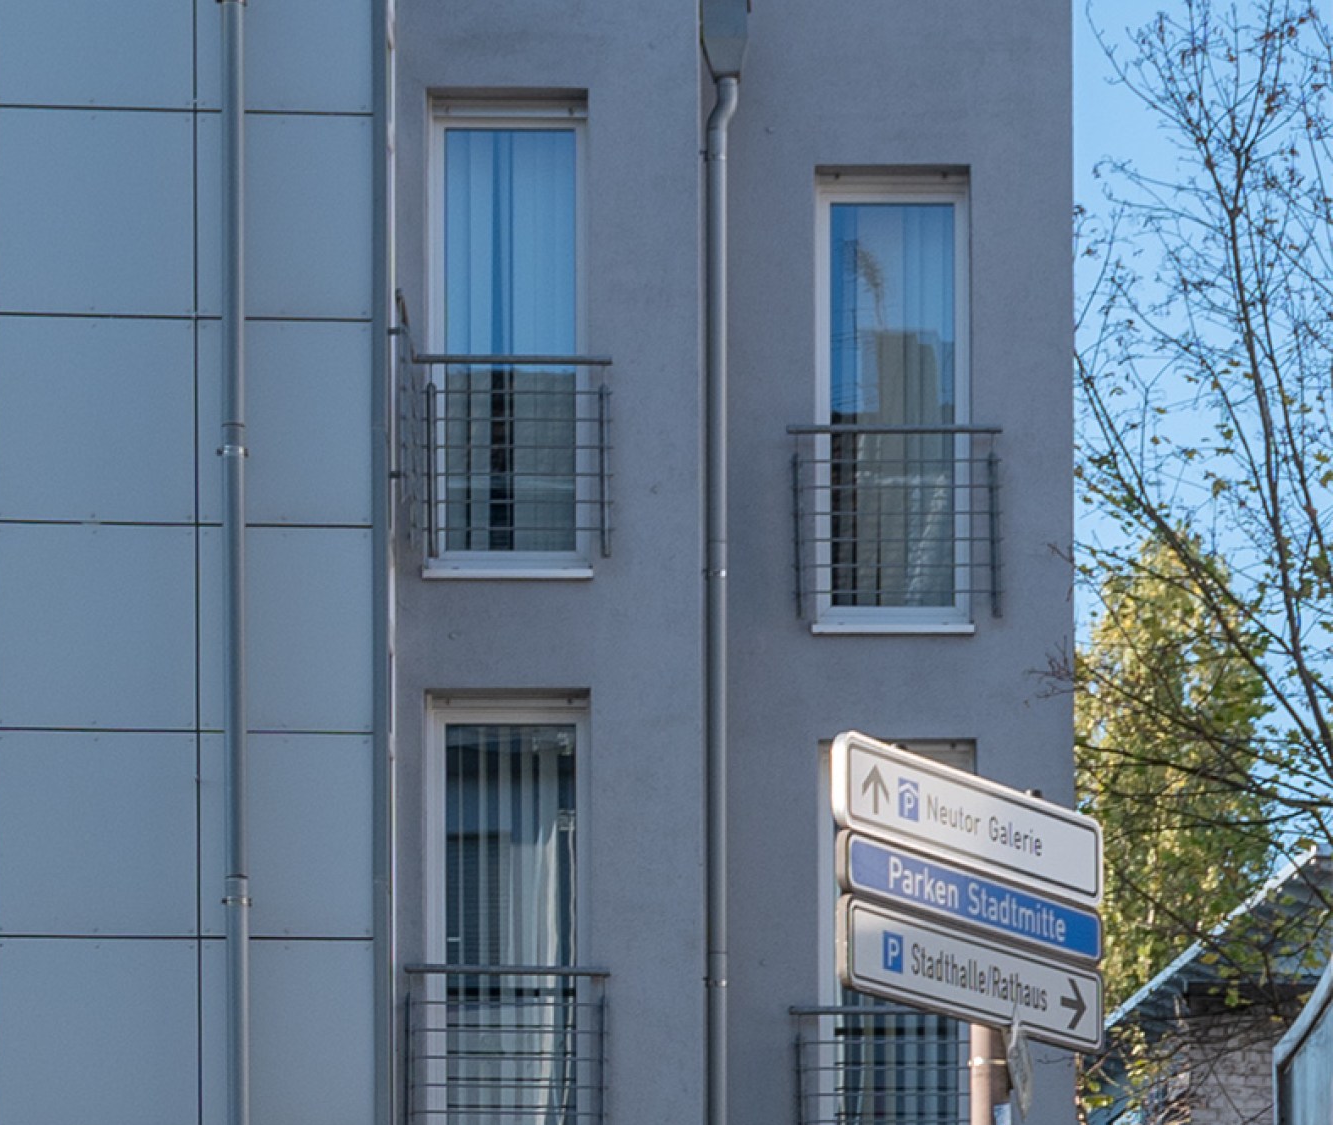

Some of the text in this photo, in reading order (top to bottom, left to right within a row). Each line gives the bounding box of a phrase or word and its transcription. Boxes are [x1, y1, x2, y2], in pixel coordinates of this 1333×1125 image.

[926, 796, 981, 836] Neutor
[988, 816, 1043, 857] Galerie
[888, 855, 1067, 943] Parken Stadtmitte
[910, 943, 1048, 1013] Stadthalle/Rathaus
